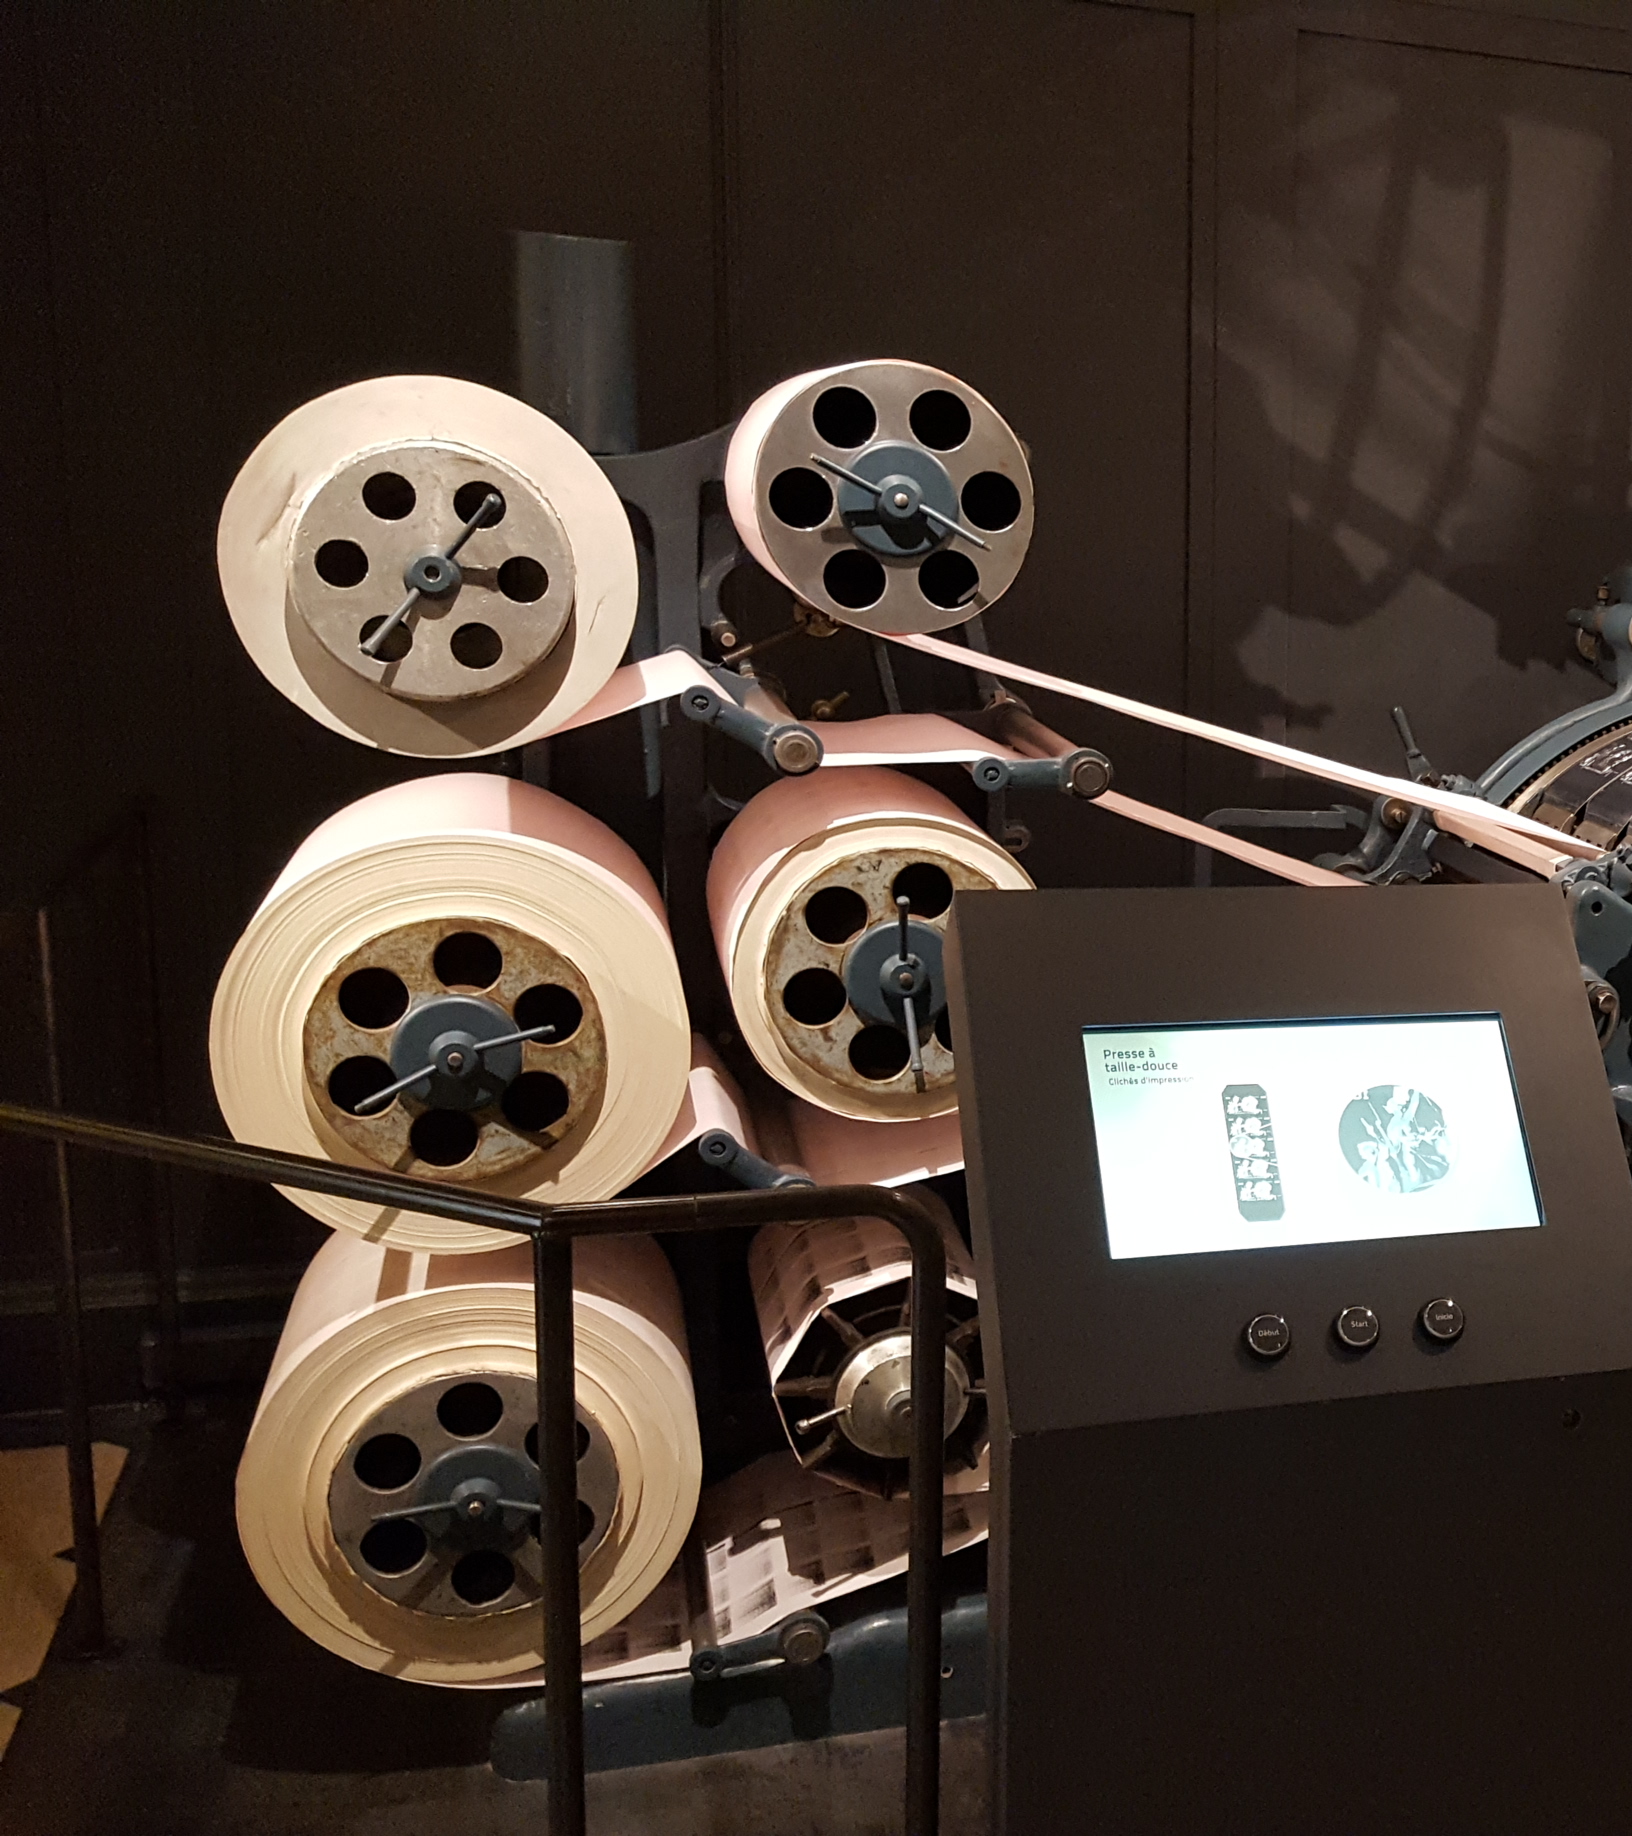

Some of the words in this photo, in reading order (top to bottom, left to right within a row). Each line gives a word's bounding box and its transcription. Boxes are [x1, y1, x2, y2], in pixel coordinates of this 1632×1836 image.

[1103, 1049, 1145, 1060] Presse
[1148, 1047, 1156, 1058] à
[1104, 1060, 1178, 1072] taille-douce
[1108, 1077, 1138, 1086] Clichés
[1350, 1319, 1369, 1328] Start
[1258, 1328, 1280, 1337] Début
